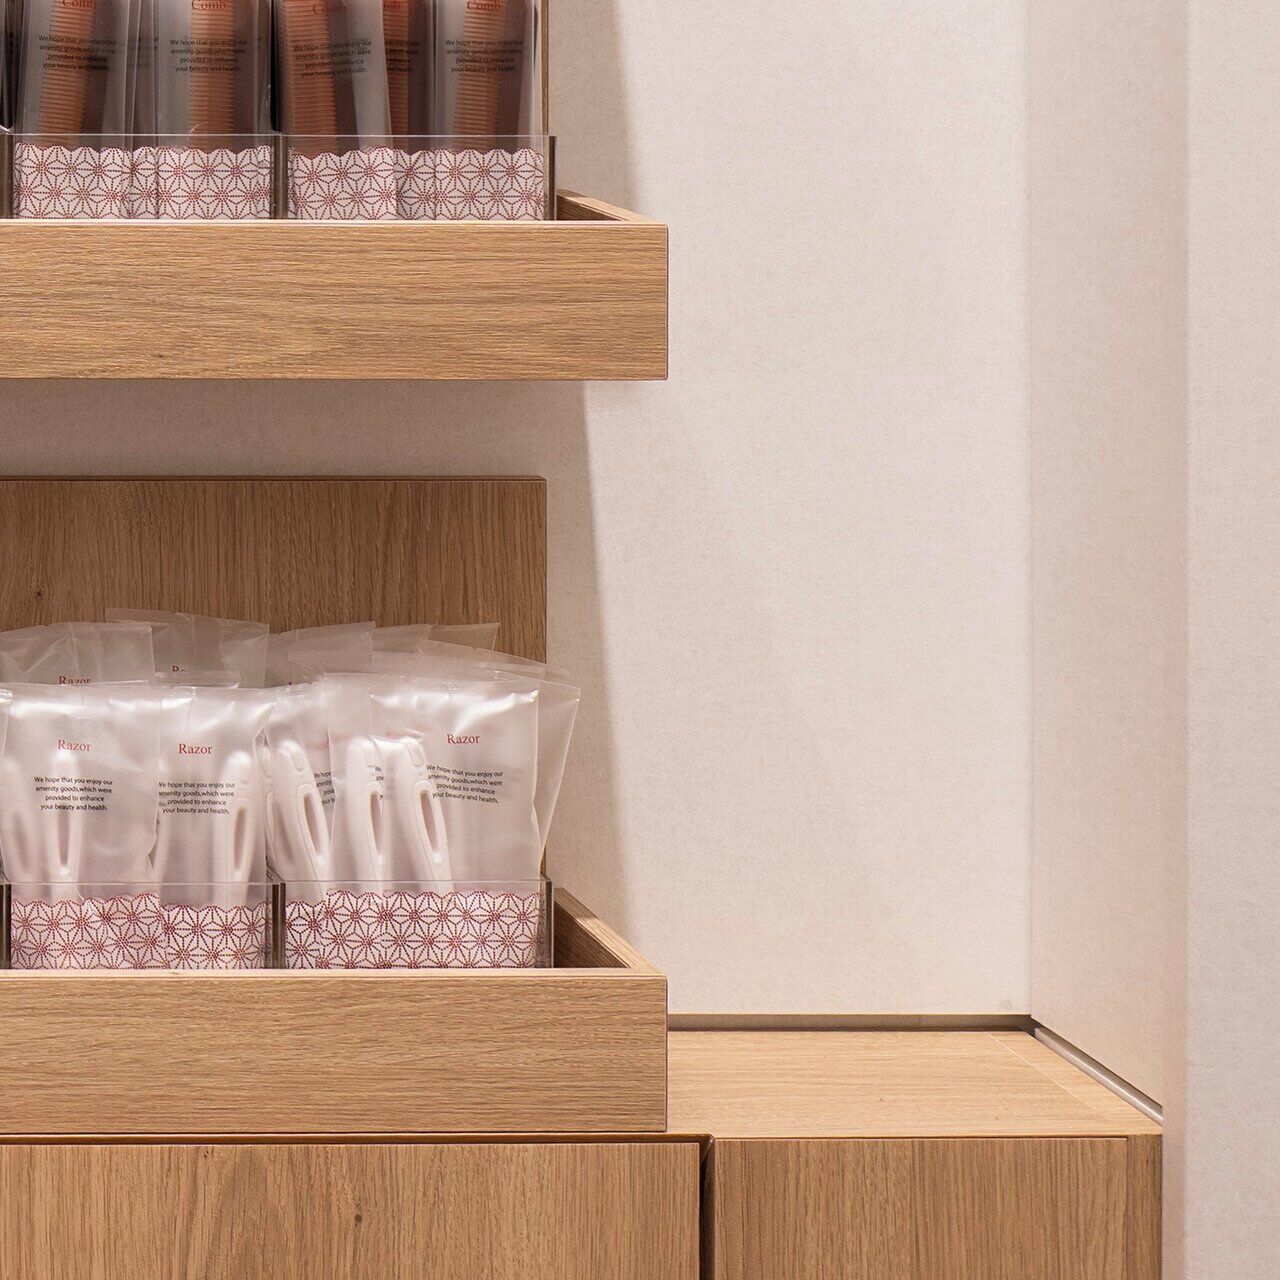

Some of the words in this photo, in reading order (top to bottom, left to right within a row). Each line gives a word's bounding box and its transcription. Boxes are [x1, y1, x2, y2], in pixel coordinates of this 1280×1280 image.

[191, 0, 226, 10] Comb
[467, 0, 501, 11] Comb
[446, 734, 480, 744] Razor
[57, 739, 92, 751] Razor
[178, 743, 213, 754] Razor
